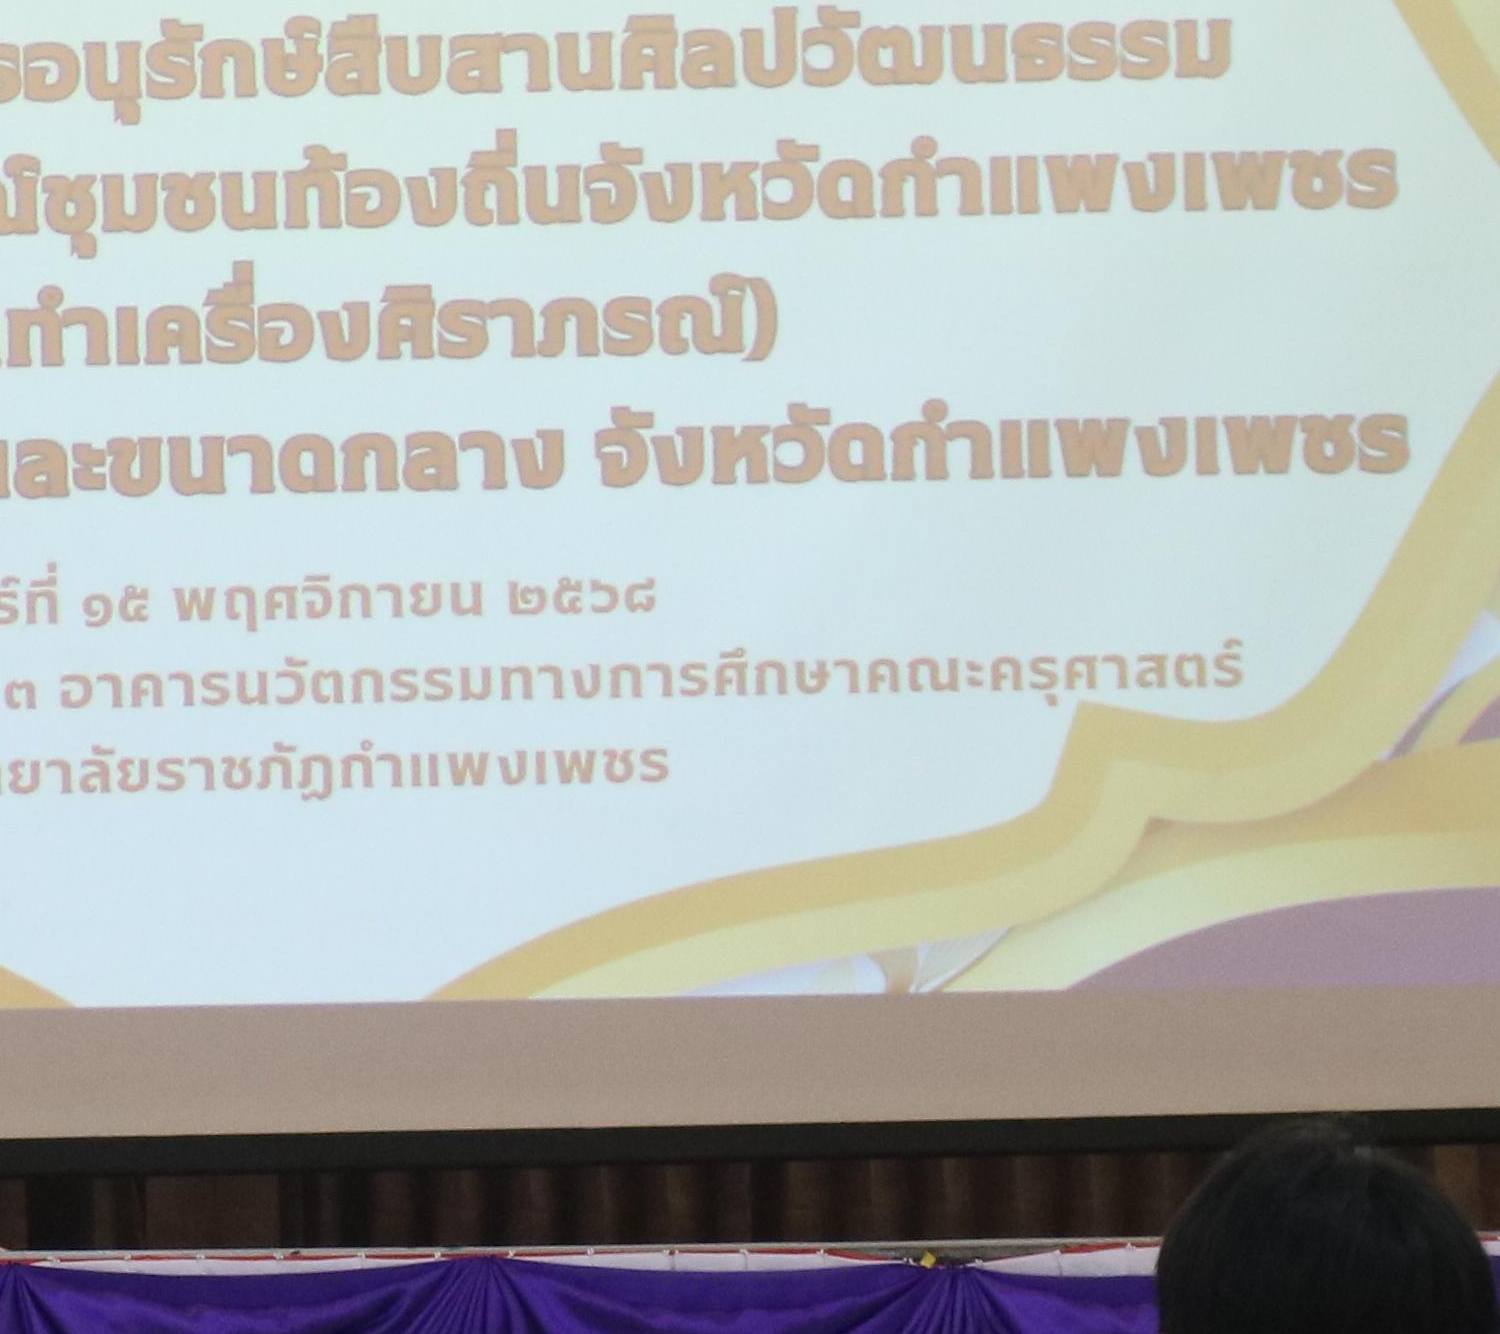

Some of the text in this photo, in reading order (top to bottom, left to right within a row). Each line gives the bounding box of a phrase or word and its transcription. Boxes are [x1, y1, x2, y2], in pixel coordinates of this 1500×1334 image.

[595, 399, 1411, 491] จังหวัดกำแพงเพชร
[82, 584, 152, 628] ๑๕
[174, 574, 484, 633] พฤศจิกายน
[507, 576, 657, 617] ๒๕๖๘
[3, 679, 38, 710] ๓
[60, 638, 1246, 711] อาคารนวัตกรรมทางการศึกษาคณะครุศาสตร์
